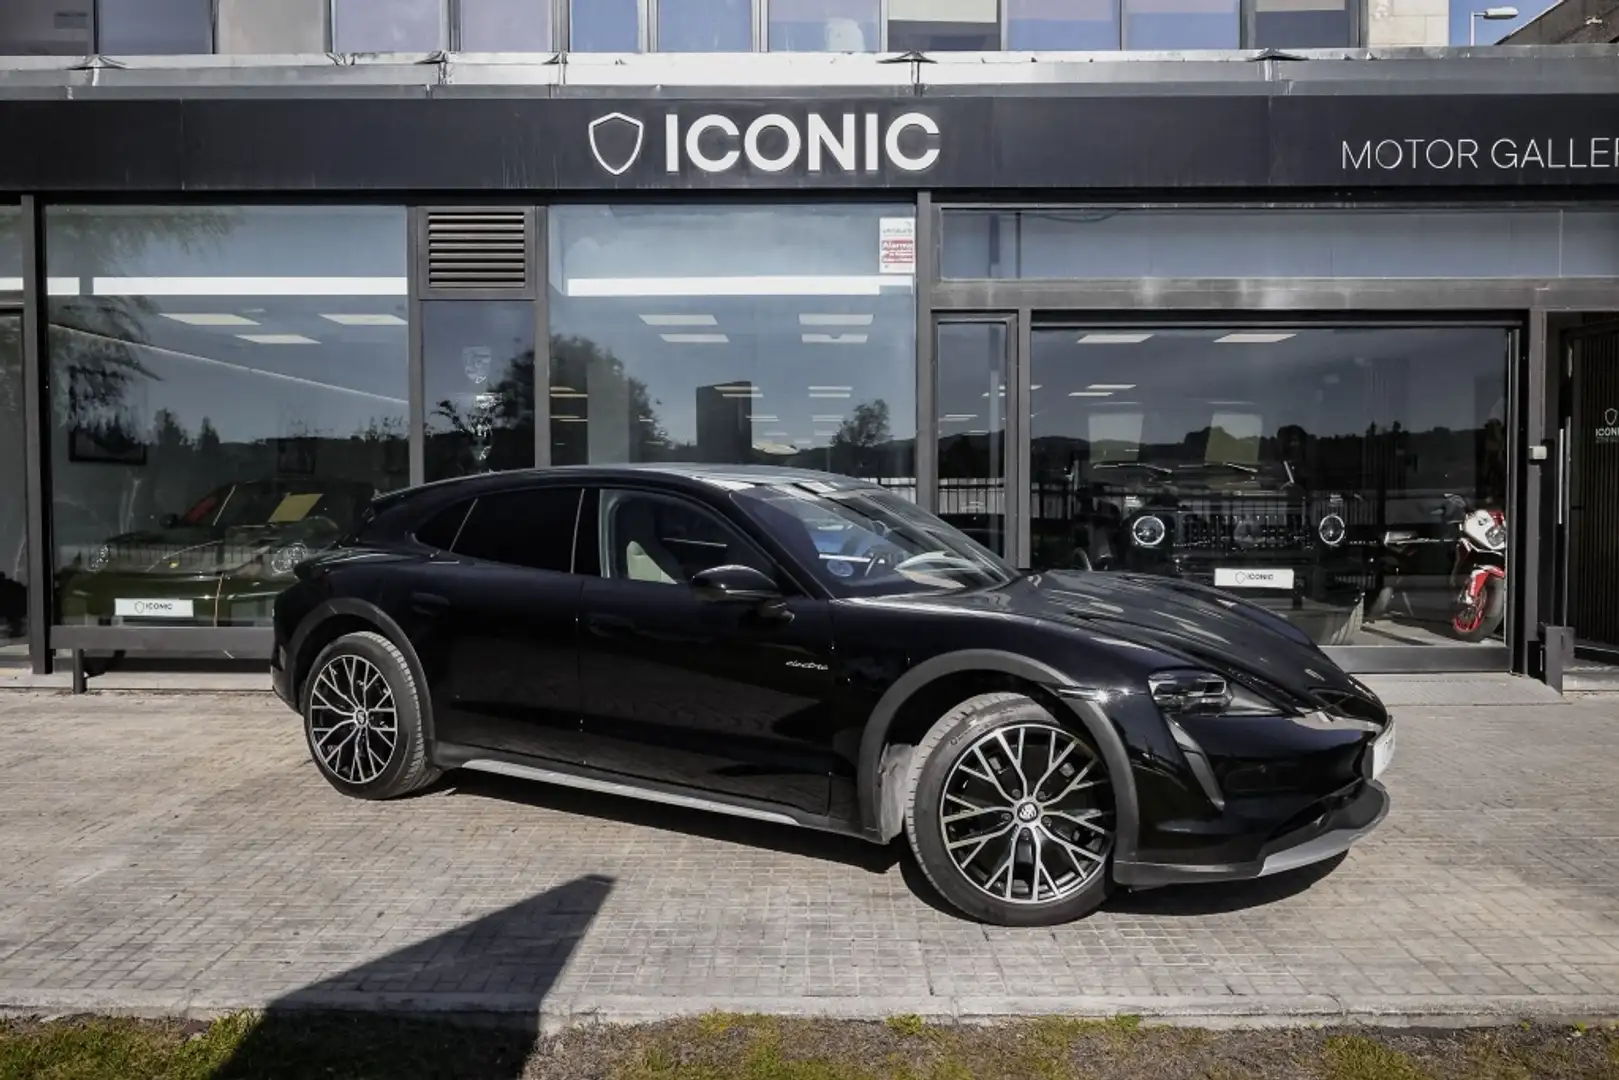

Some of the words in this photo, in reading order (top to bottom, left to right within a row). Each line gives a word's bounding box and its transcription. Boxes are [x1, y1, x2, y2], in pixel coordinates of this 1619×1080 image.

[665, 112, 941, 173] ICONIC
[1341, 138, 1479, 170] MOTOR
[1490, 138, 1619, 169] GALLE
[1247, 572, 1274, 580] ICONIC
[145, 602, 173, 610] ICONIC
